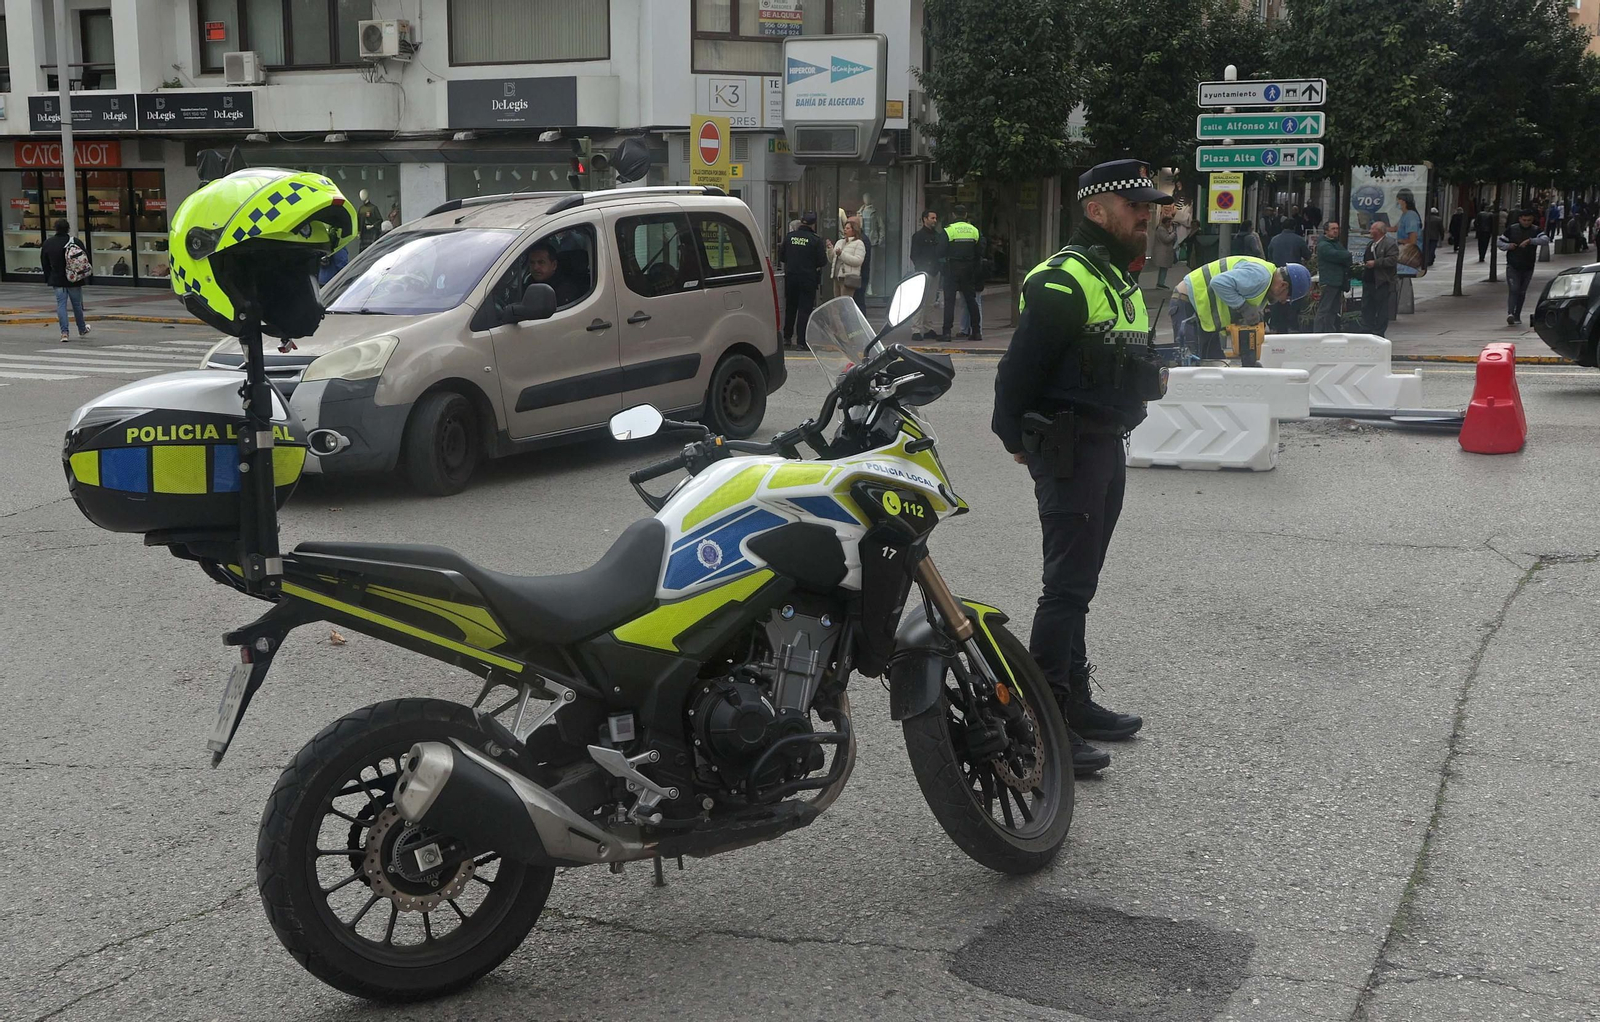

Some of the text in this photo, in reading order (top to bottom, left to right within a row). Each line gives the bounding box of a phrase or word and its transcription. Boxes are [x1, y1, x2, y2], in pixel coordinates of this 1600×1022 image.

[762, 10, 801, 19] SE ALQUILA
[789, 67, 816, 75] HIPERCOR
[714, 84, 740, 108] K3
[1203, 91, 1257, 99] ayuntamiento
[492, 98, 529, 112] DeLegis
[795, 97, 865, 107] BAHÍA DE ALGECIRAS
[37, 113, 61, 123] DeLegis
[102, 111, 128, 122] DeLegis
[147, 111, 176, 121] DeLegis
[213, 109, 244, 120] DeLegis
[729, 116, 757, 126] ORES
[1226, 122, 1265, 131] Alfonso
[1267, 121, 1278, 130] XI
[1203, 153, 1256, 163] Plaza Alta
[1357, 196, 1381, 206] 70€
[126, 423, 295, 444] POLICIA LAL
[866, 462, 935, 488] POLICIA LOCAL
[903, 501, 925, 519] 112
[882, 545, 898, 560] 17
